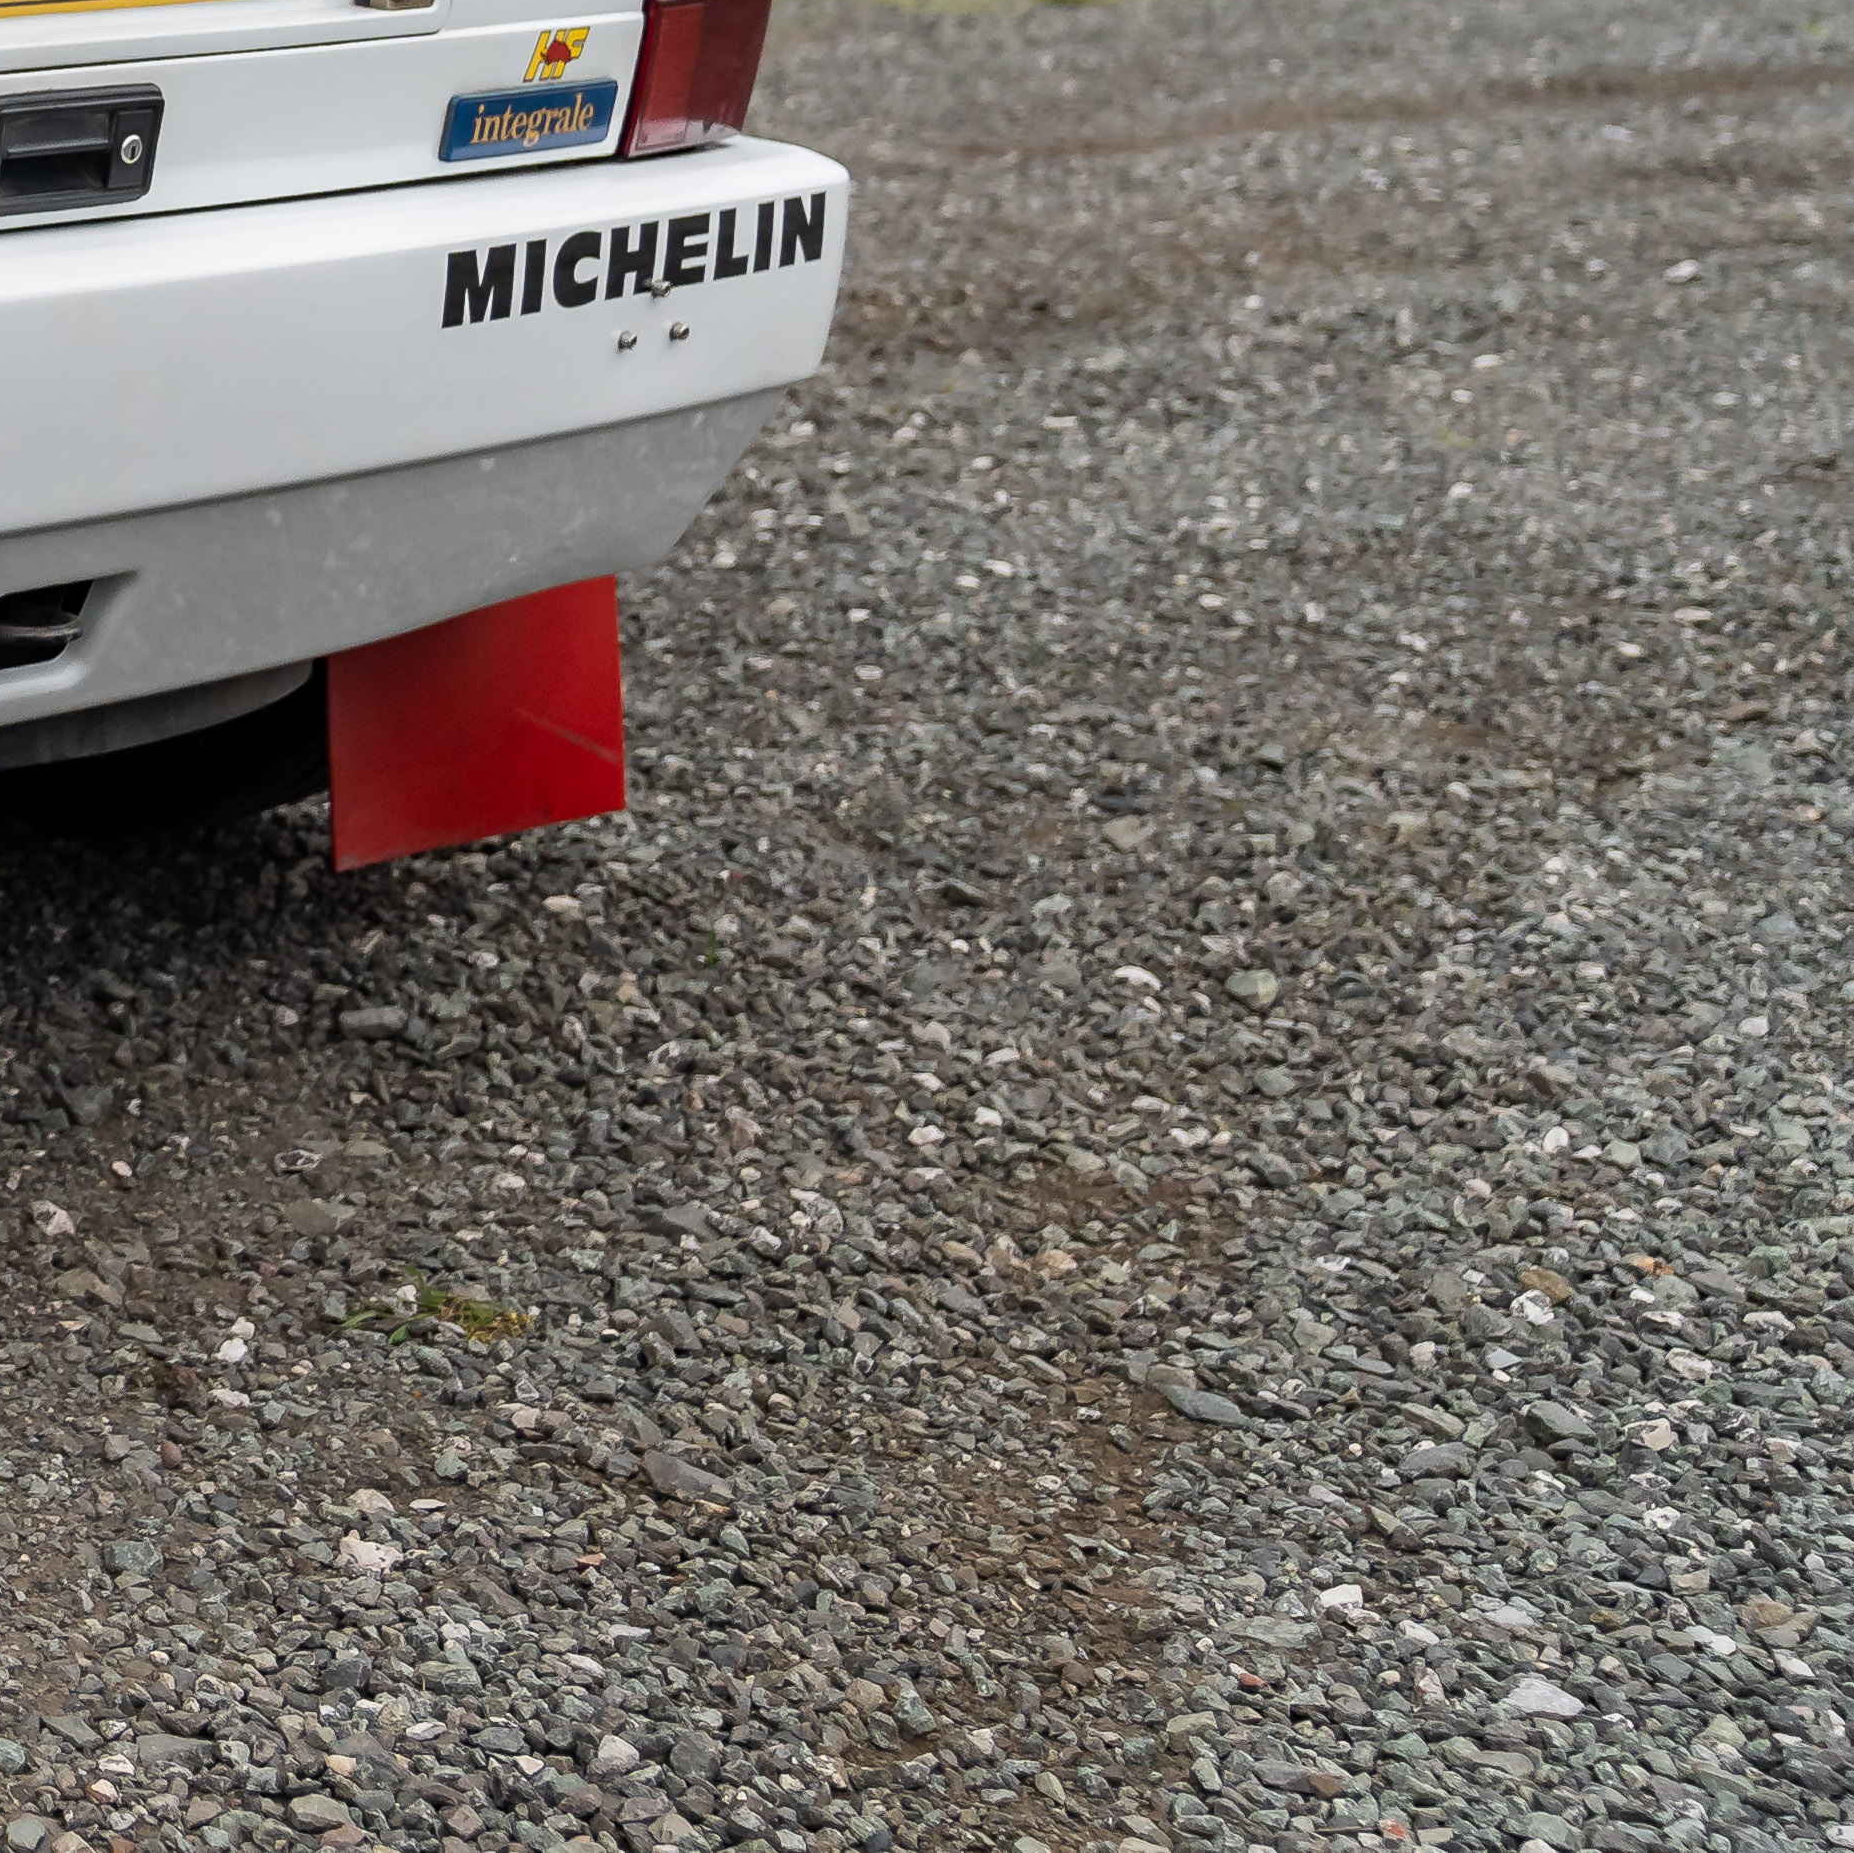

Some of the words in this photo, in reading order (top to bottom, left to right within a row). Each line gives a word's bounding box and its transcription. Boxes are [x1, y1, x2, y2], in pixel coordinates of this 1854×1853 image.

[522, 25, 591, 83] HF
[470, 92, 594, 148] integrale
[441, 191, 827, 330] MICHELIN
